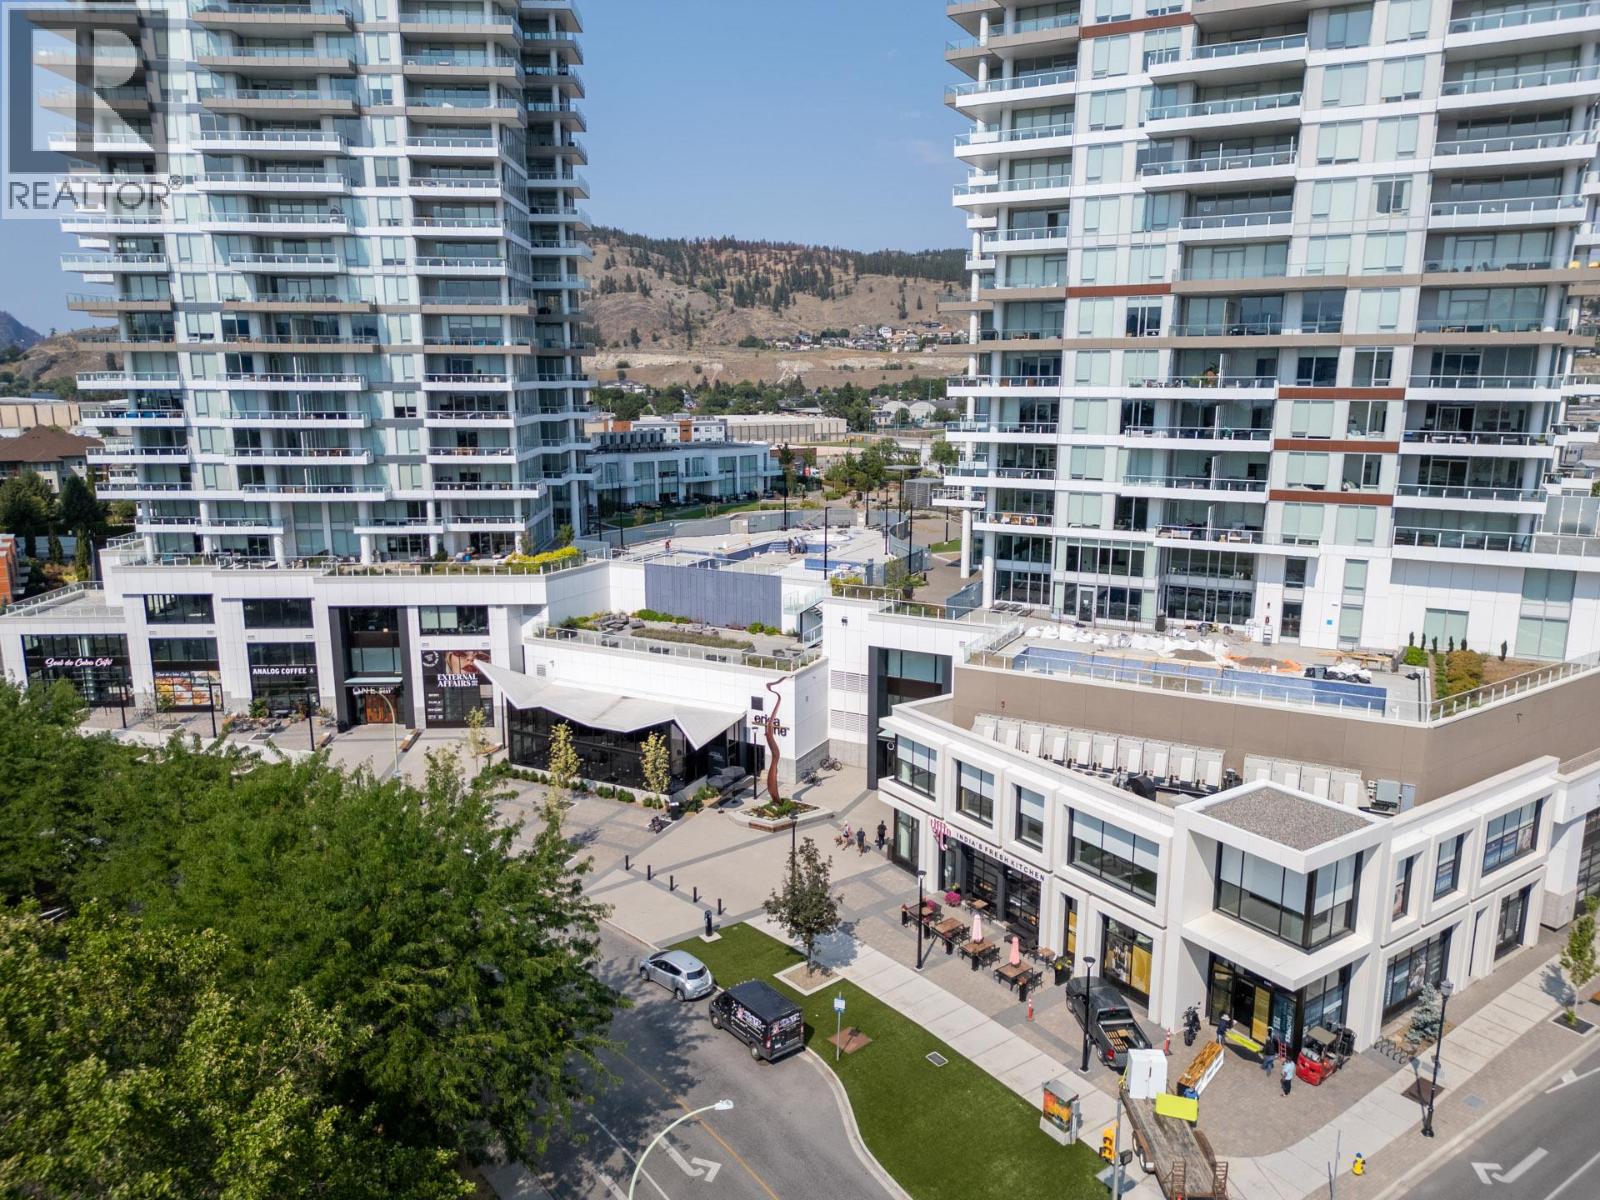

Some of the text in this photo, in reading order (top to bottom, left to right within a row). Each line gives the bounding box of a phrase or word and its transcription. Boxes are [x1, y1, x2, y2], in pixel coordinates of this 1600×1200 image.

[252, 667, 280, 675] ANALOG
[281, 667, 307, 675] COFFEE
[437, 673, 478, 681] EXTERNAL
[437, 680, 471, 688] AFFAIRS
[764, 725, 788, 737] jne
[956, 833, 983, 850] INDIA'S
[984, 847, 1009, 862] FRESH
[1010, 860, 1045, 881] KITCHEN
